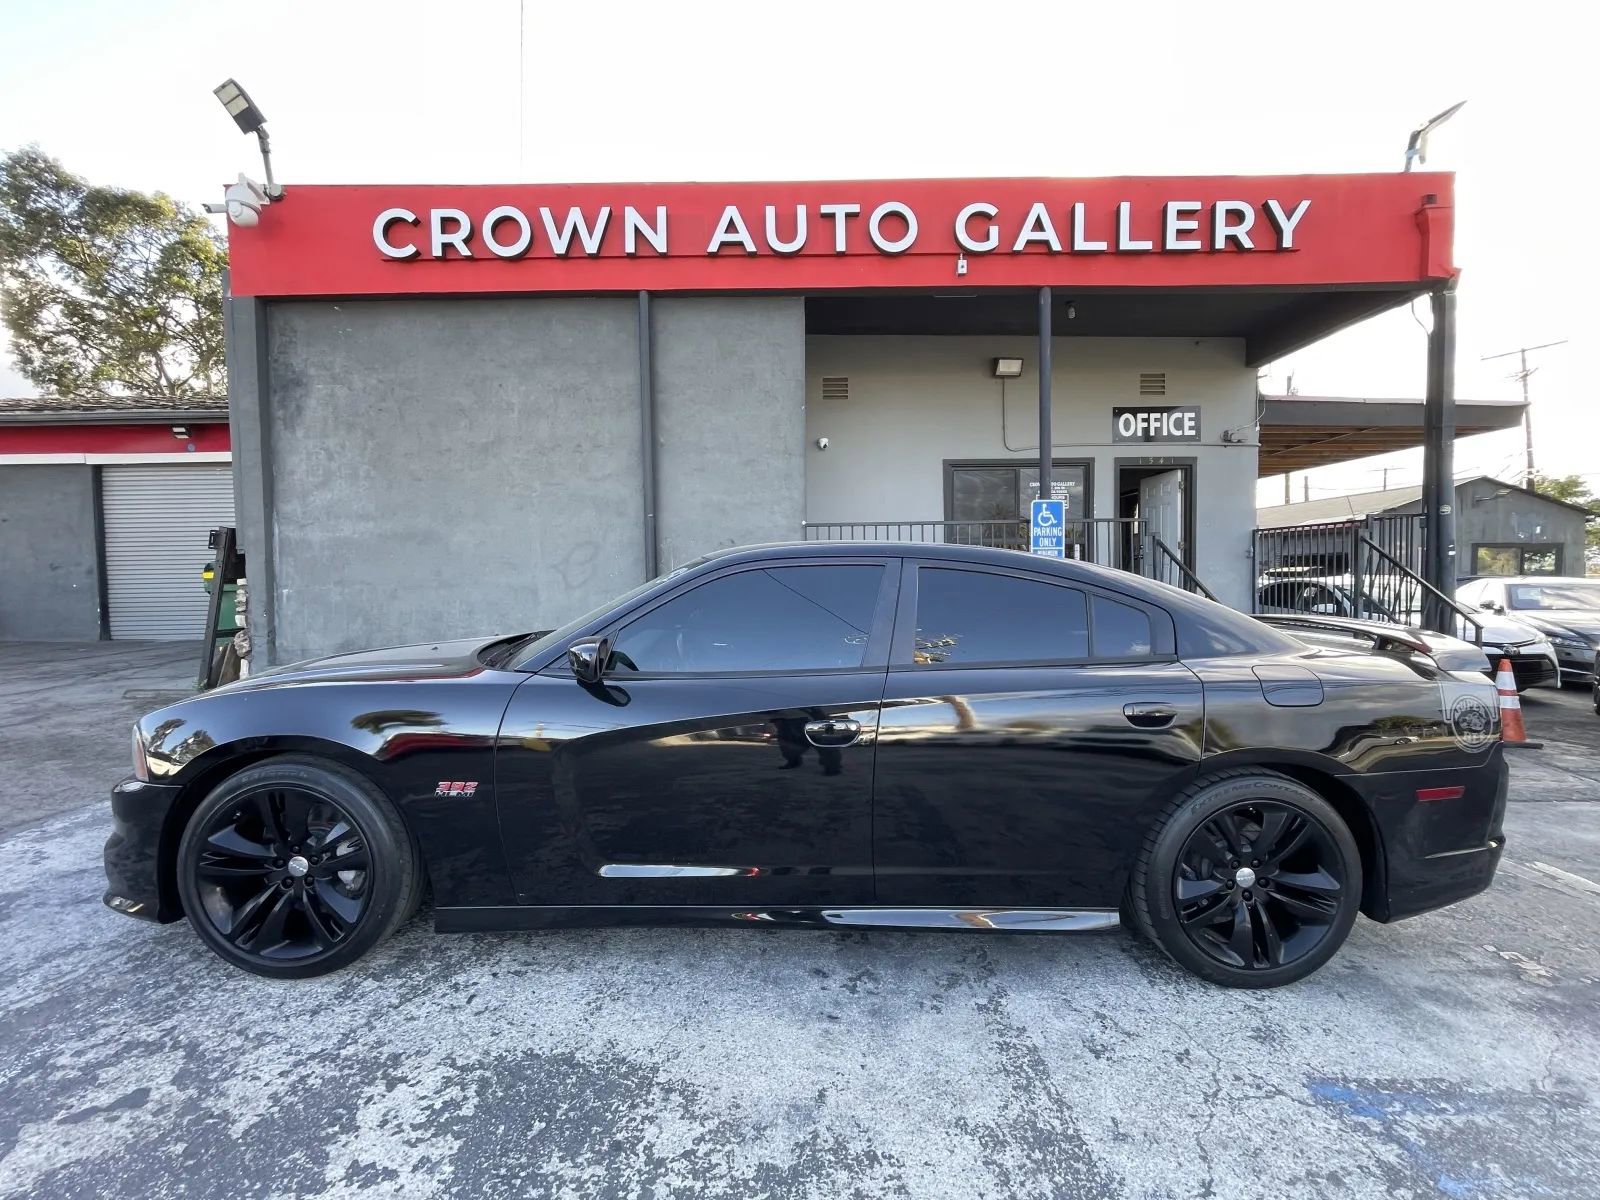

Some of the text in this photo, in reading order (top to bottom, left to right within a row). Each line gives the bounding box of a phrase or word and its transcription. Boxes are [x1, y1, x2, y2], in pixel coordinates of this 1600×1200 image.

[372, 199, 1312, 258] CROWN AUTO GALLERY
[1118, 412, 1196, 437] OFFICE
[1033, 526, 1063, 537] PARKING
[1039, 537, 1057, 547] ONLY
